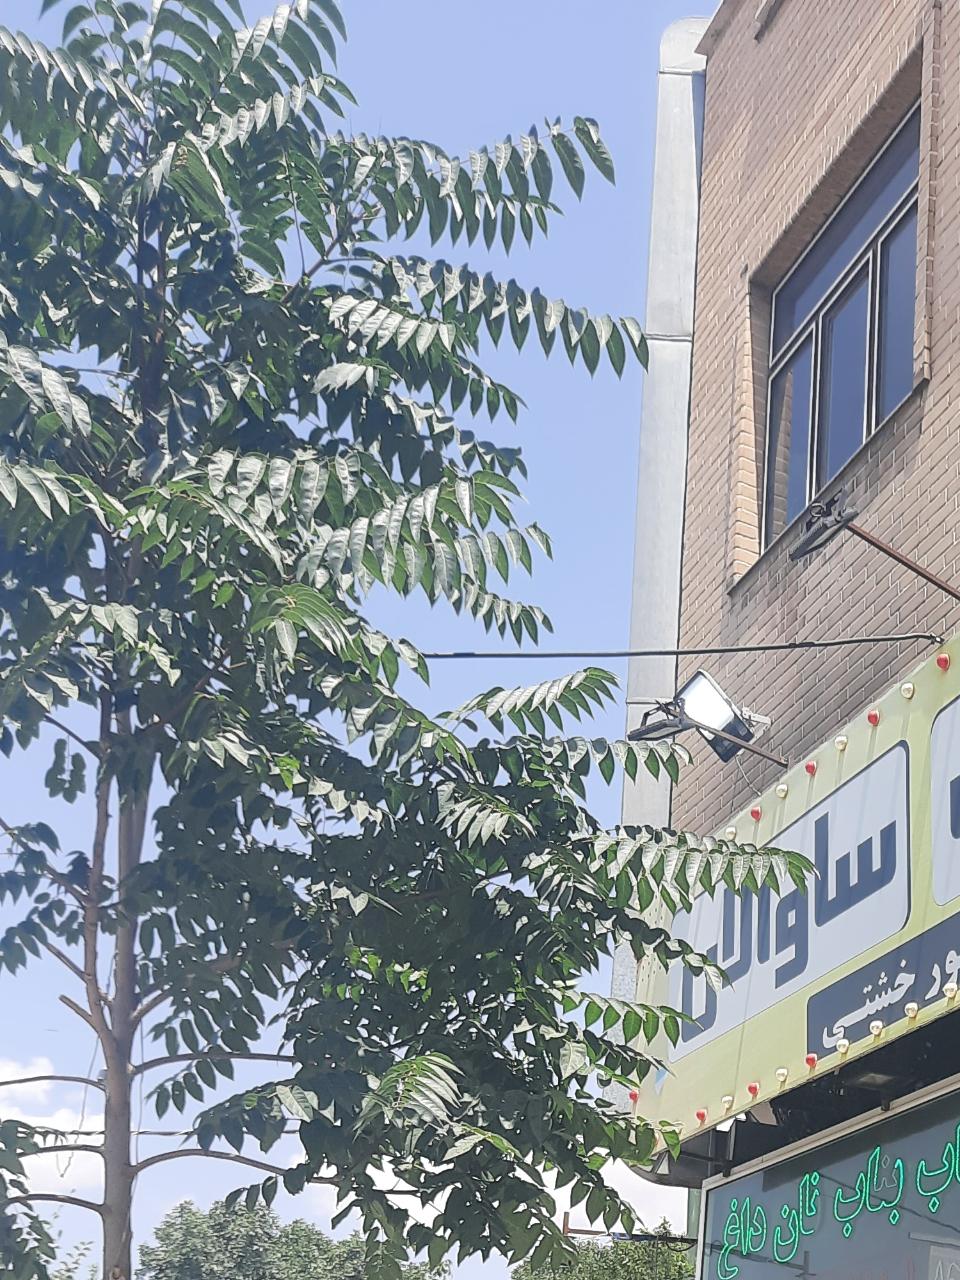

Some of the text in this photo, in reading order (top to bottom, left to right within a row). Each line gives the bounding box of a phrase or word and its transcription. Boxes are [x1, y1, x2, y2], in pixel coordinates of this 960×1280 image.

[822, 959, 916, 1049] خشتی
[773, 1171, 820, 1263] نان
[834, 1146, 904, 1238] بناب
[717, 1197, 768, 1280] داغ
